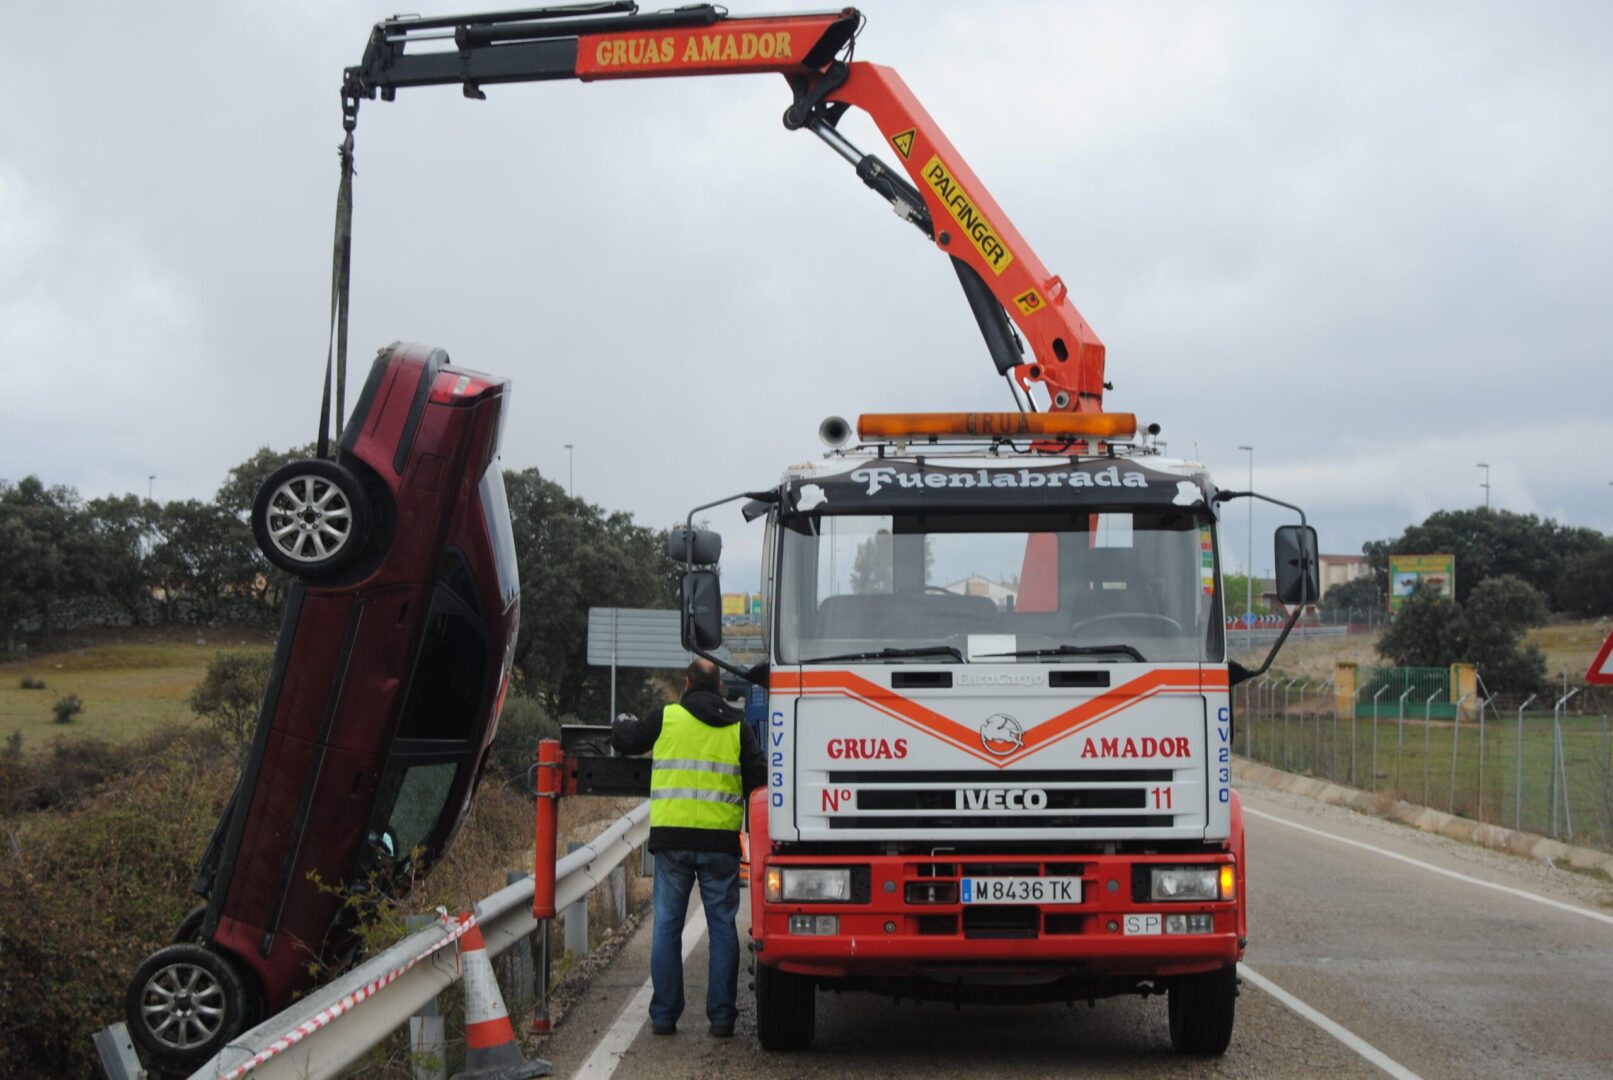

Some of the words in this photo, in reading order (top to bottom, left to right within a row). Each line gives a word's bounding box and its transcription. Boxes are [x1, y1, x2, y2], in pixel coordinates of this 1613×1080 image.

[596, 37, 674, 65] GRUAS
[682, 32, 791, 62] AMADOR
[928, 164, 1004, 266] PALFINGER
[851, 466, 1148, 495] Fuenlabrada
[827, 738, 908, 759] GRUAS
[1080, 737, 1191, 758] AMADOR
[955, 789, 1048, 810] IVECO
[1151, 787, 1172, 810] 11
